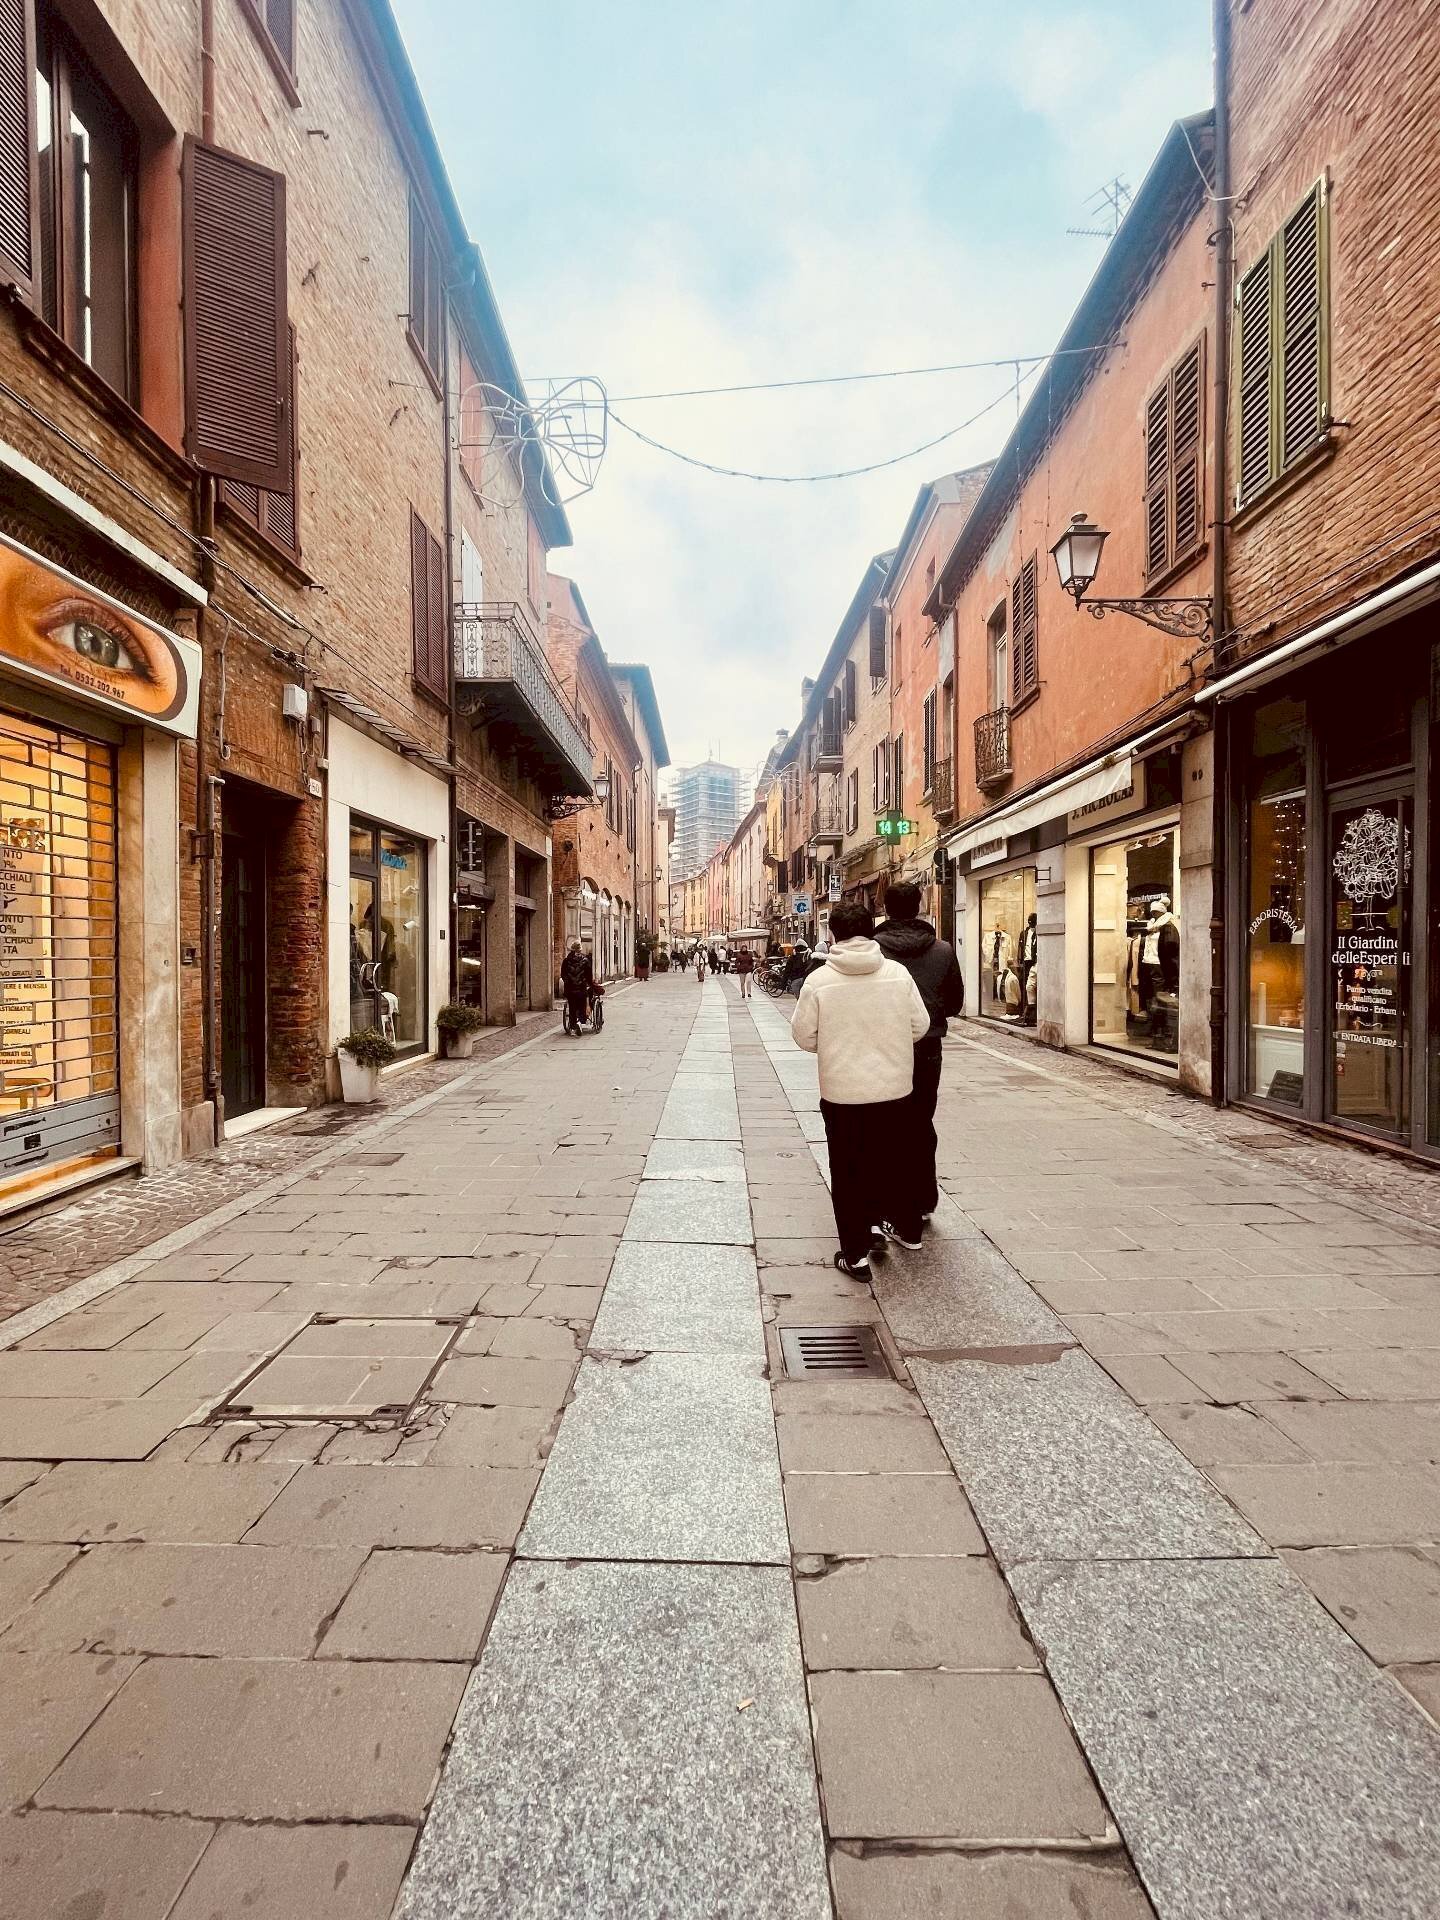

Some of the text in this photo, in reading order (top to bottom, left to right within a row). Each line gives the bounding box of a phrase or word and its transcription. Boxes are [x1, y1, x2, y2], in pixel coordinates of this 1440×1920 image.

[897, 821, 910, 834] 13
[1248, 908, 1298, 936] ERBORISTERIA
[1346, 985, 1393, 996] Punto vendita
[1351, 995, 1387, 1005] qualificato
[1341, 1032, 1371, 1044] ENTRATA
